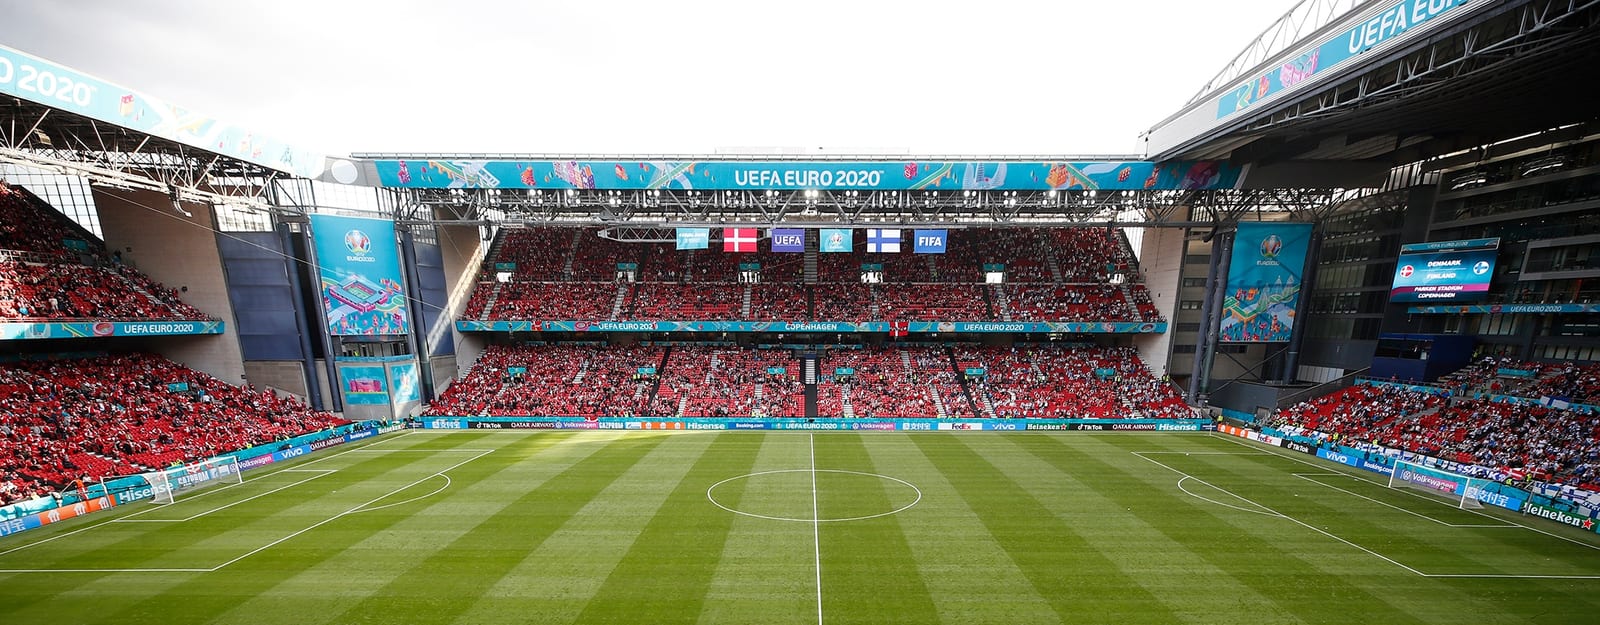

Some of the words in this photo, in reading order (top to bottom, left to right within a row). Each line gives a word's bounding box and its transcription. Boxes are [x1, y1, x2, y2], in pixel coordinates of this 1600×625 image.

[1348, 4, 1407, 53] UEFA
[735, 170, 782, 186] UEFA
[784, 170, 833, 186] EURO
[774, 236, 802, 246] UEFA
[918, 236, 942, 247] FIFA
[124, 325, 149, 334] UEFA
[149, 324, 173, 333] EURO
[173, 324, 194, 332] 2020
[1158, 423, 1197, 431] Hisense
[310, 440, 326, 450] QATAR
[327, 436, 345, 447] AIRWAYS
[1257, 433, 1272, 444] FedEx
[281, 448, 303, 458] vivo
[1293, 443, 1309, 454] TikTok
[238, 456, 272, 469] Volkswagen
[1326, 451, 1347, 463] vivo
[1364, 460, 1394, 474] Booking.com
[120, 483, 174, 504] Hisense
